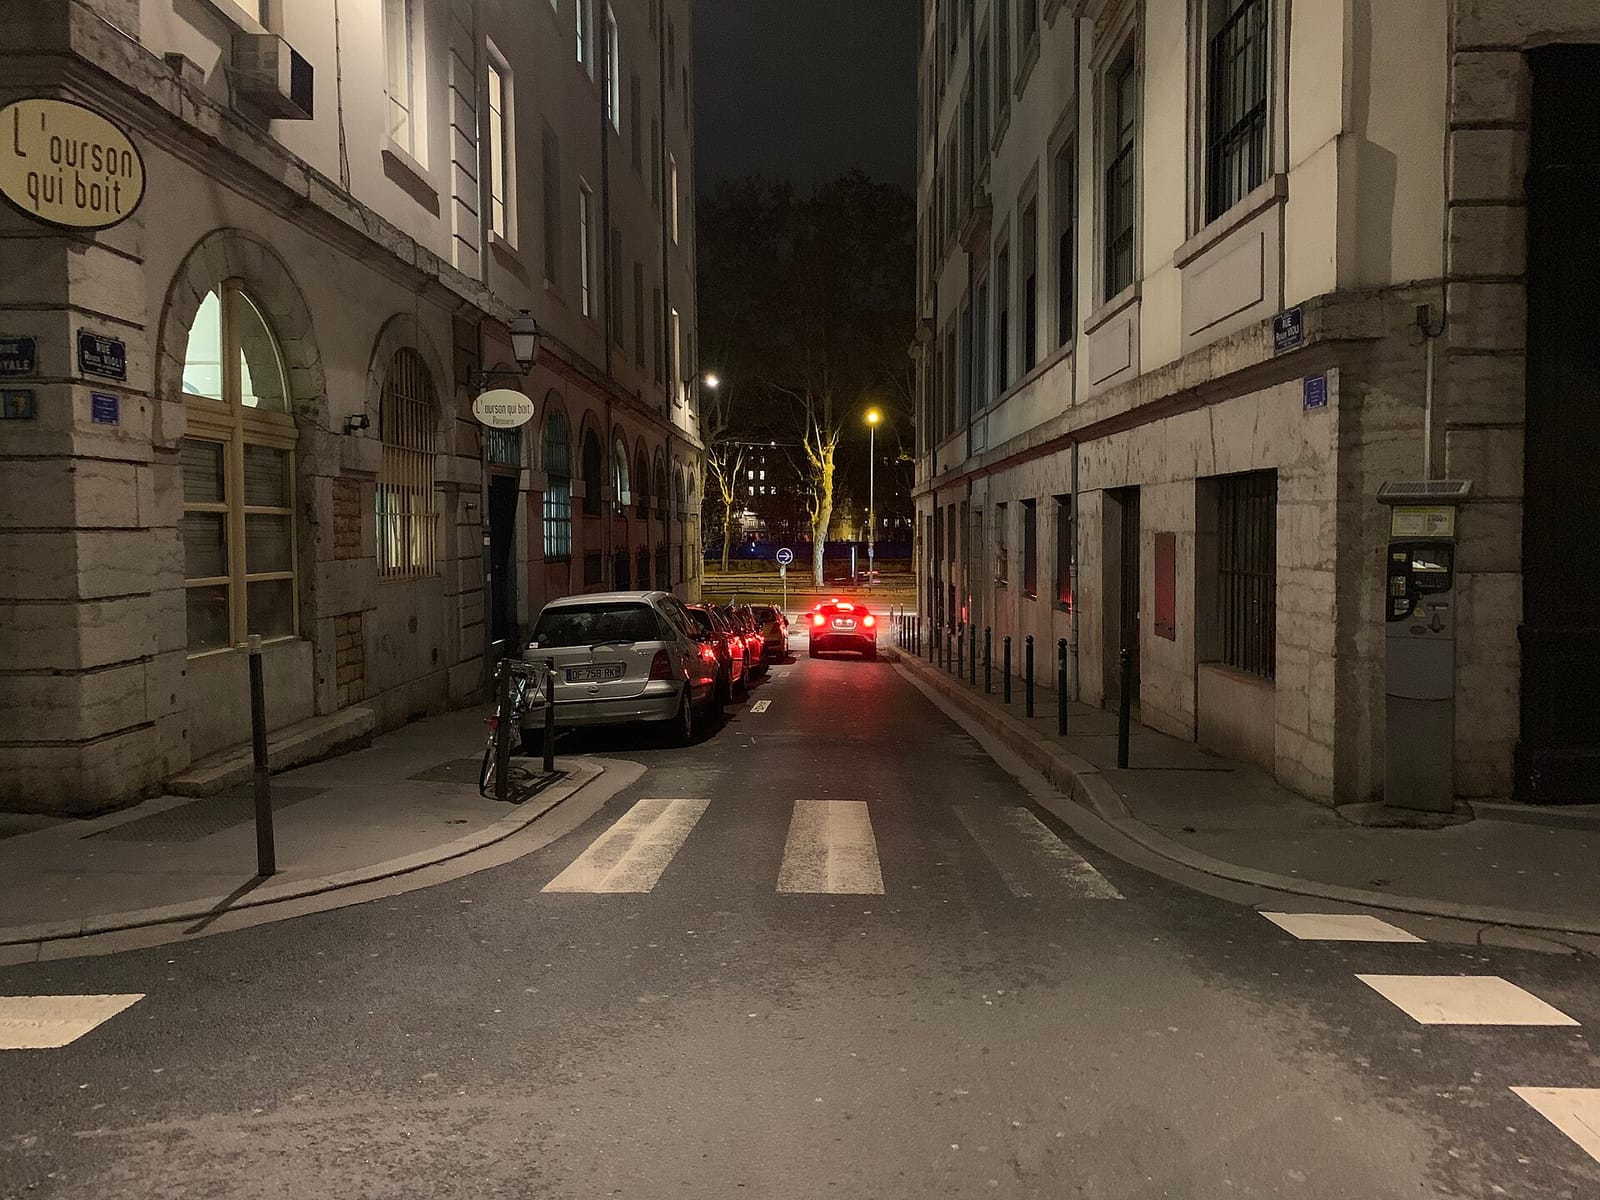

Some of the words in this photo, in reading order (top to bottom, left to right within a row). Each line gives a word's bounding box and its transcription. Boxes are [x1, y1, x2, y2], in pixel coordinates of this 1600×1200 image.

[14, 106, 132, 178] L'ourson
[27, 167, 63, 211] qui
[75, 170, 121, 214] boit
[95, 342, 111, 355] RUE
[0, 359, 31, 371] YALE
[507, 402, 517, 416] qui
